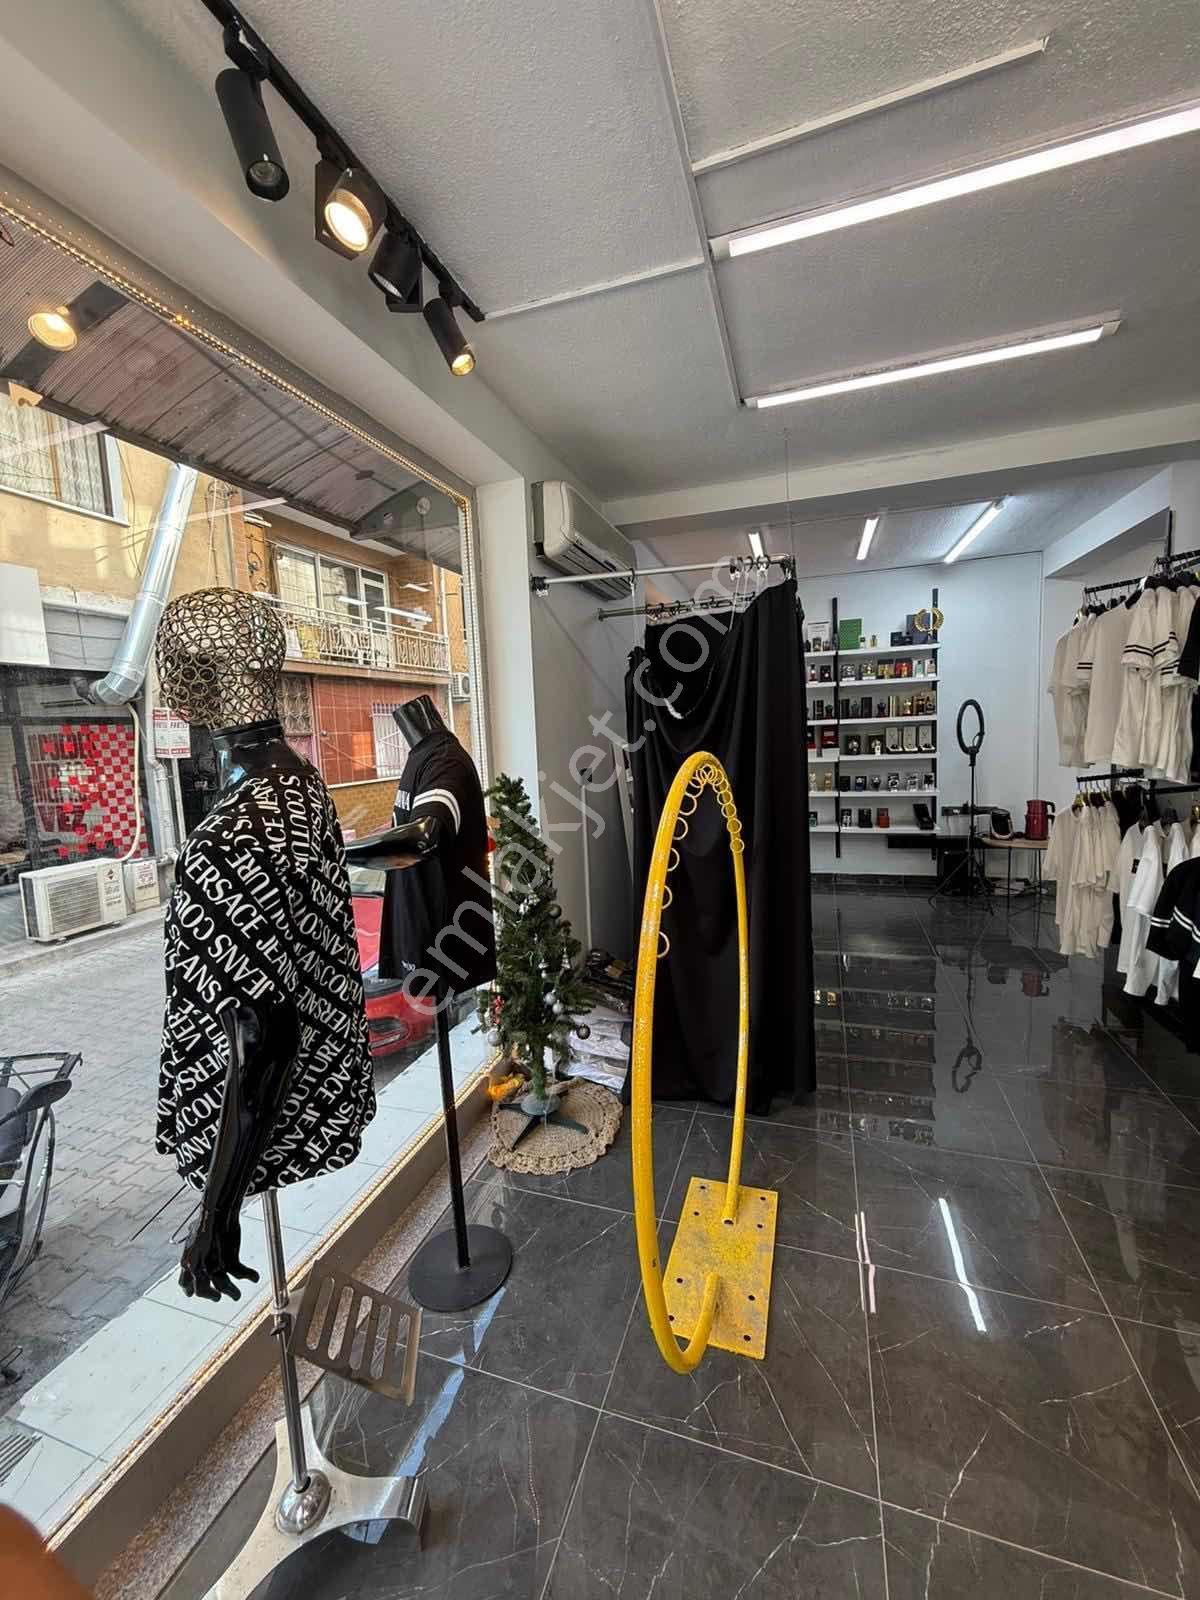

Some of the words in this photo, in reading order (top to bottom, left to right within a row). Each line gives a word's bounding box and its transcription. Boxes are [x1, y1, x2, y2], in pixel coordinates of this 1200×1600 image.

[184, 851, 268, 939] VERSACE
[255, 934, 300, 993] JEANS
[208, 933, 276, 1000] JEANS
[263, 1103, 321, 1166] JEANS
[303, 1101, 355, 1164] JEANS
